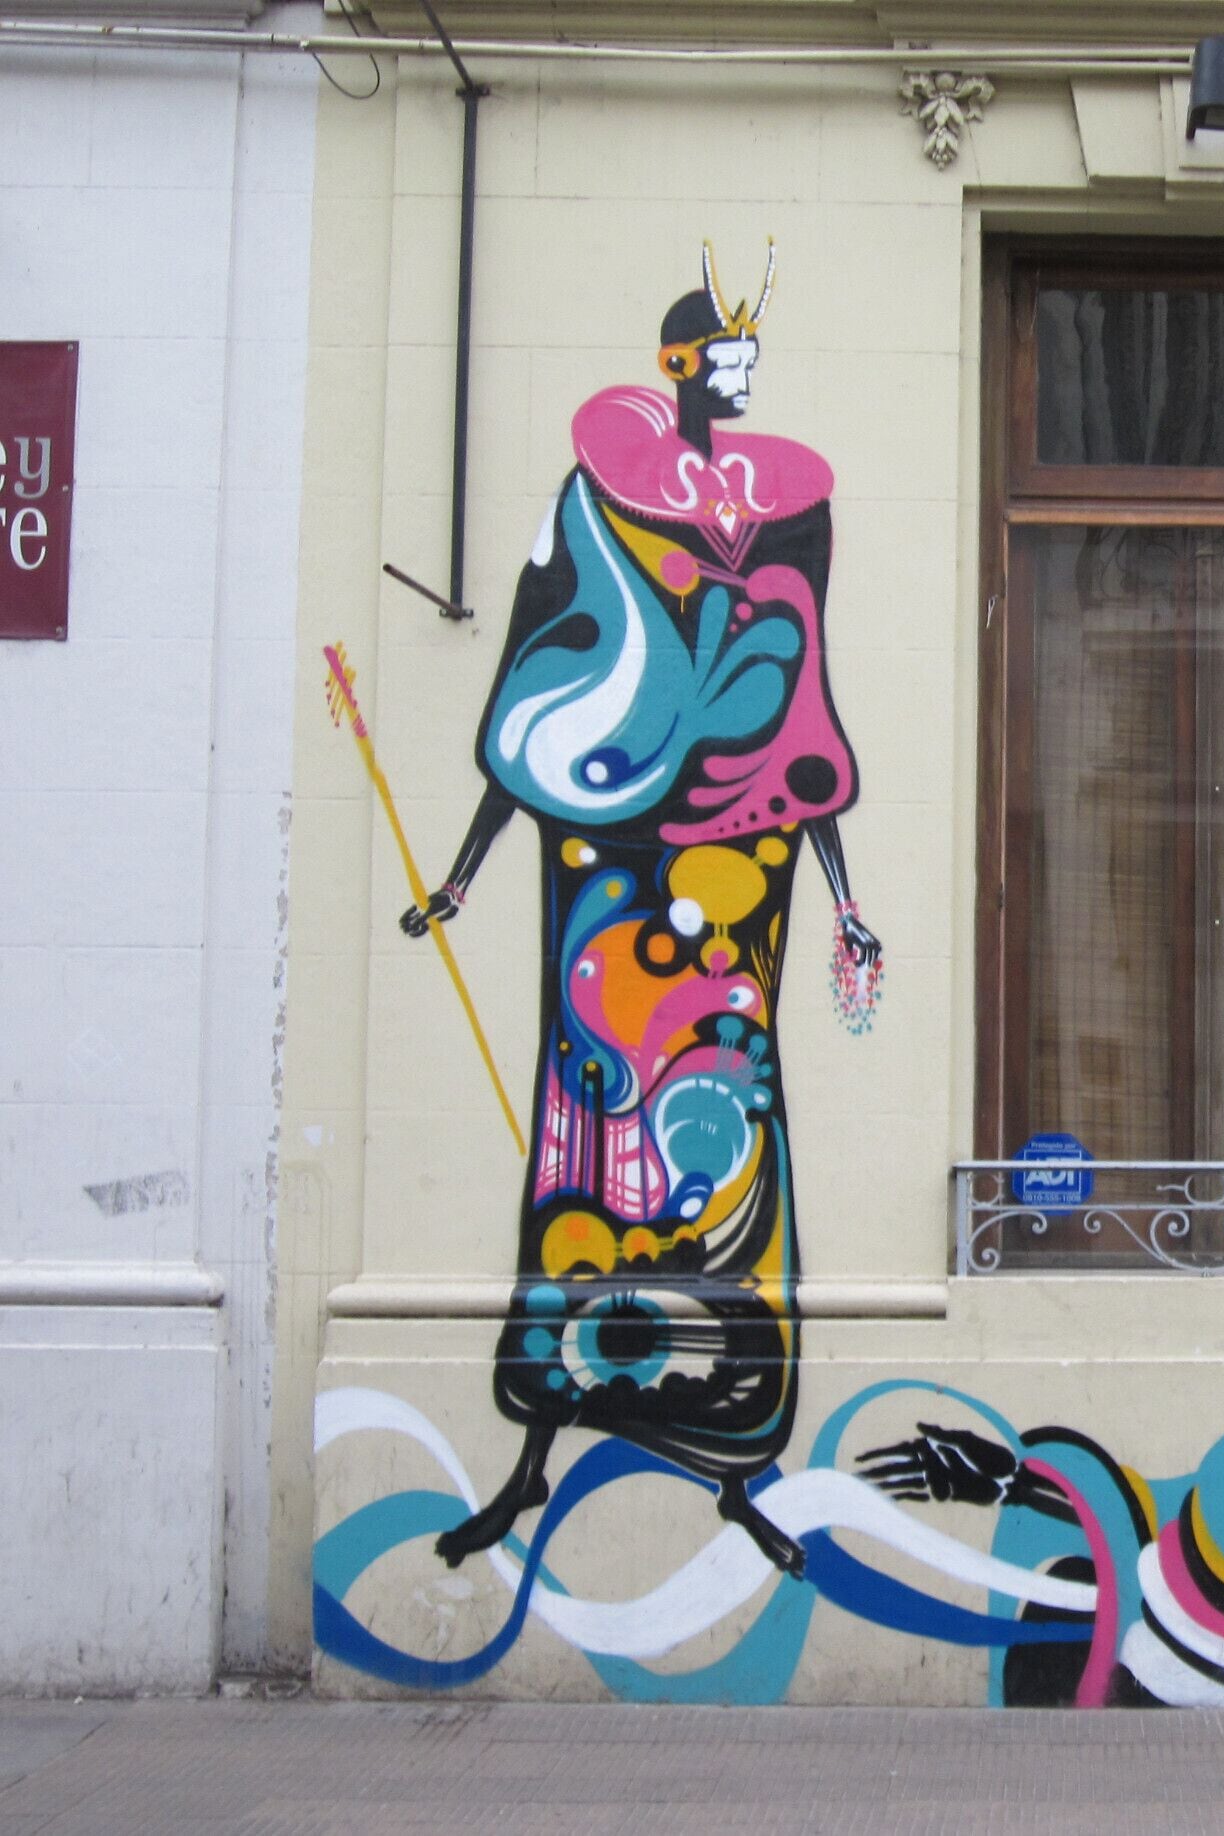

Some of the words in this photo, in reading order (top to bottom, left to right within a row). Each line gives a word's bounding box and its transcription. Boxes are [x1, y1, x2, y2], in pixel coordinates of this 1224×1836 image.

[0, 437, 50, 498] y
[0, 507, 47, 570] e
[1025, 1156, 1080, 1186] ADT
